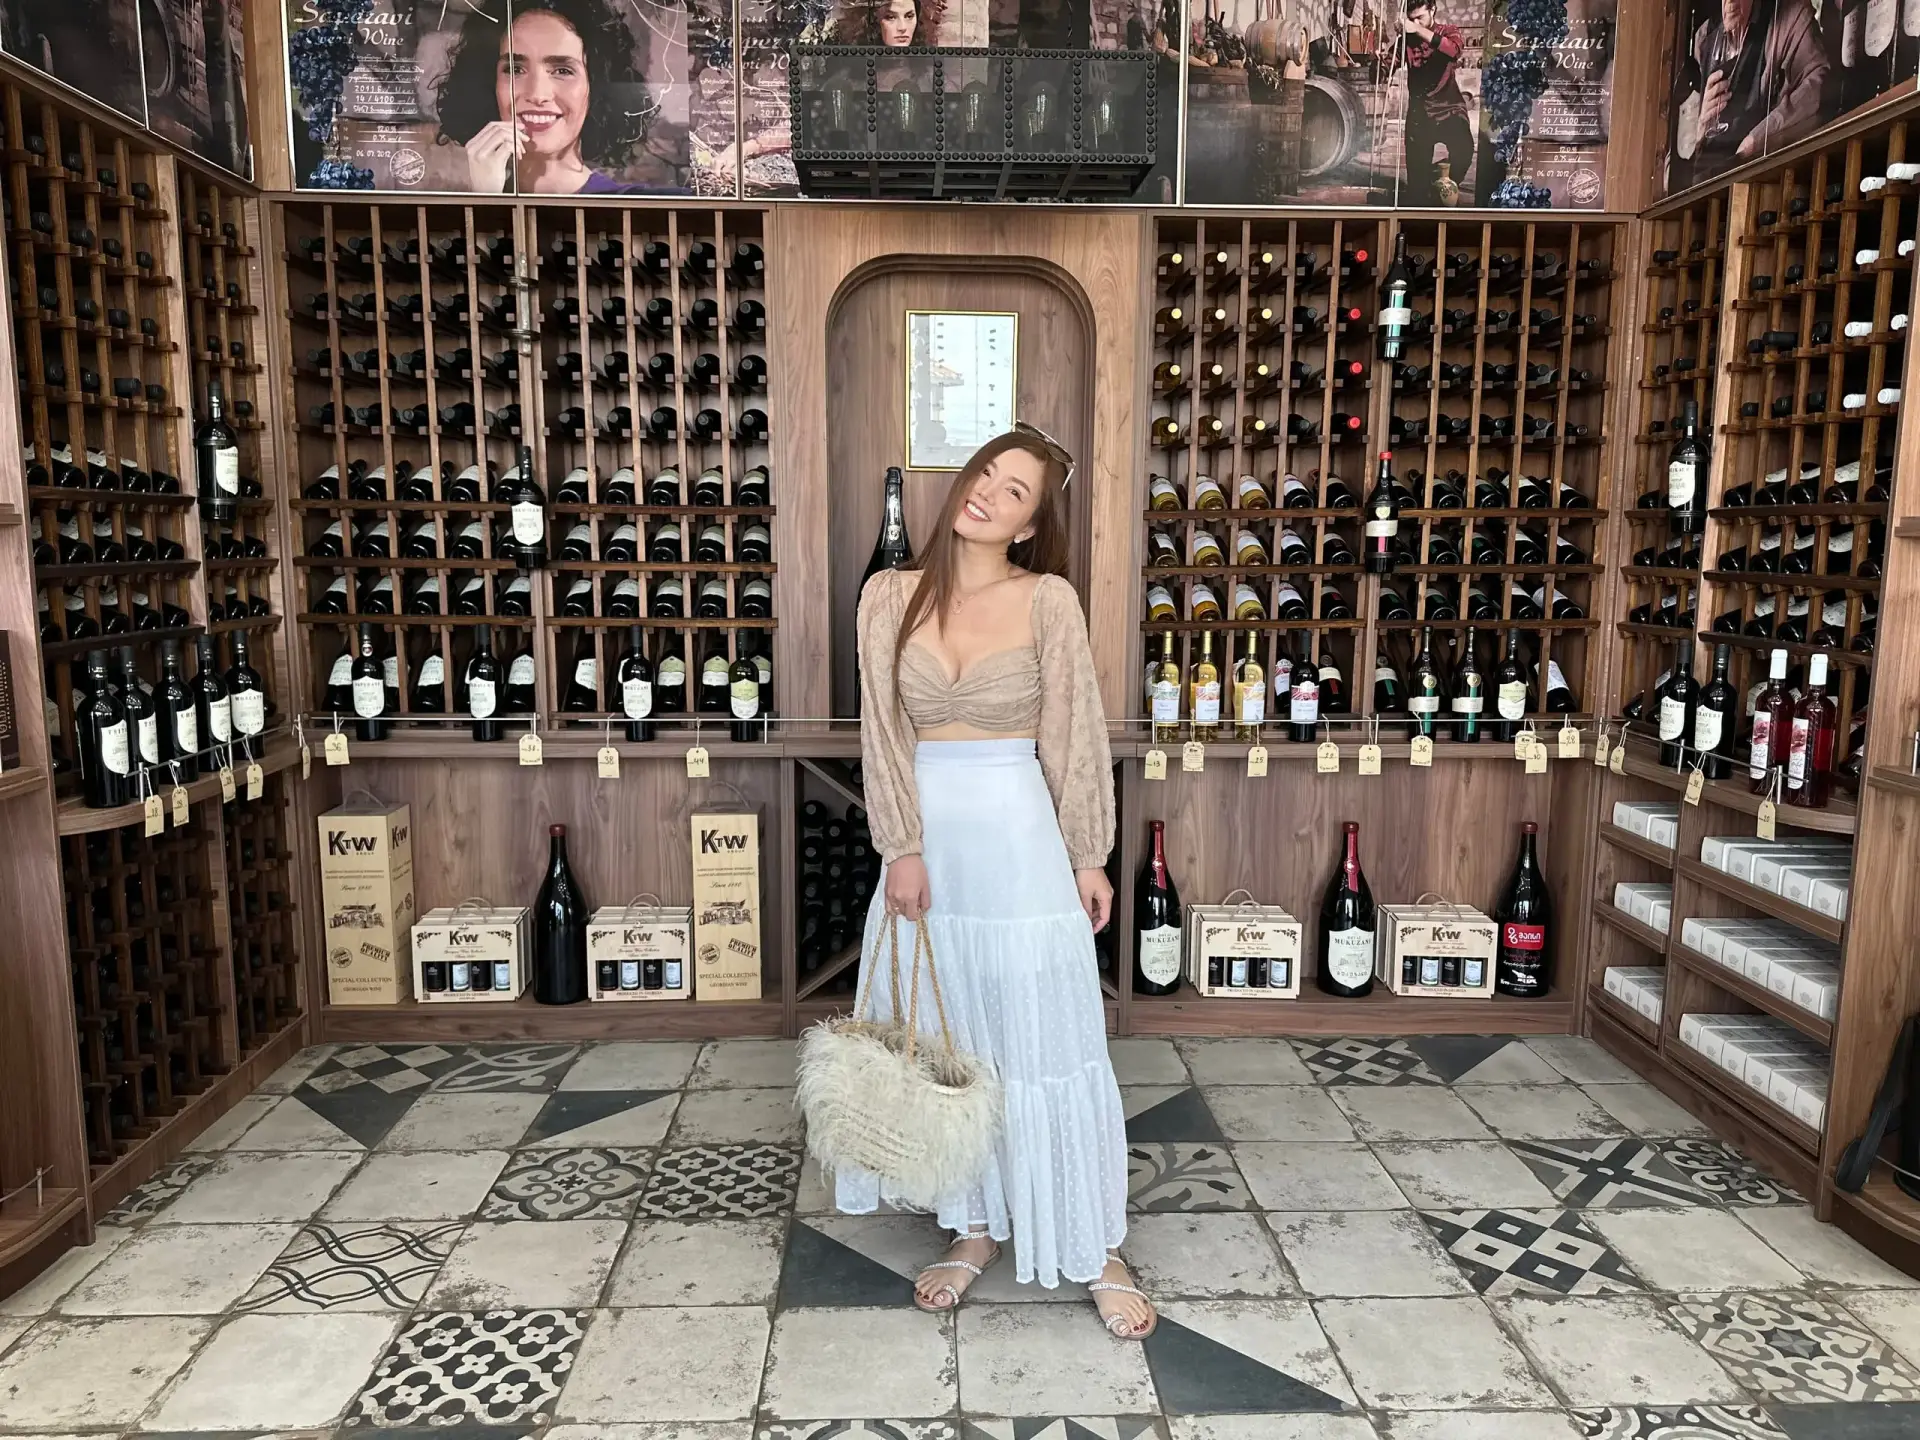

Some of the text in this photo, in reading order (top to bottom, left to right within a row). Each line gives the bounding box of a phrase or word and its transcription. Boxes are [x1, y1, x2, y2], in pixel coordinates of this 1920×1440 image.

[360, 28, 405, 46] Wine
[1553, 52, 1594, 70] Wine
[1334, 938, 1371, 946] MUKUZANI
